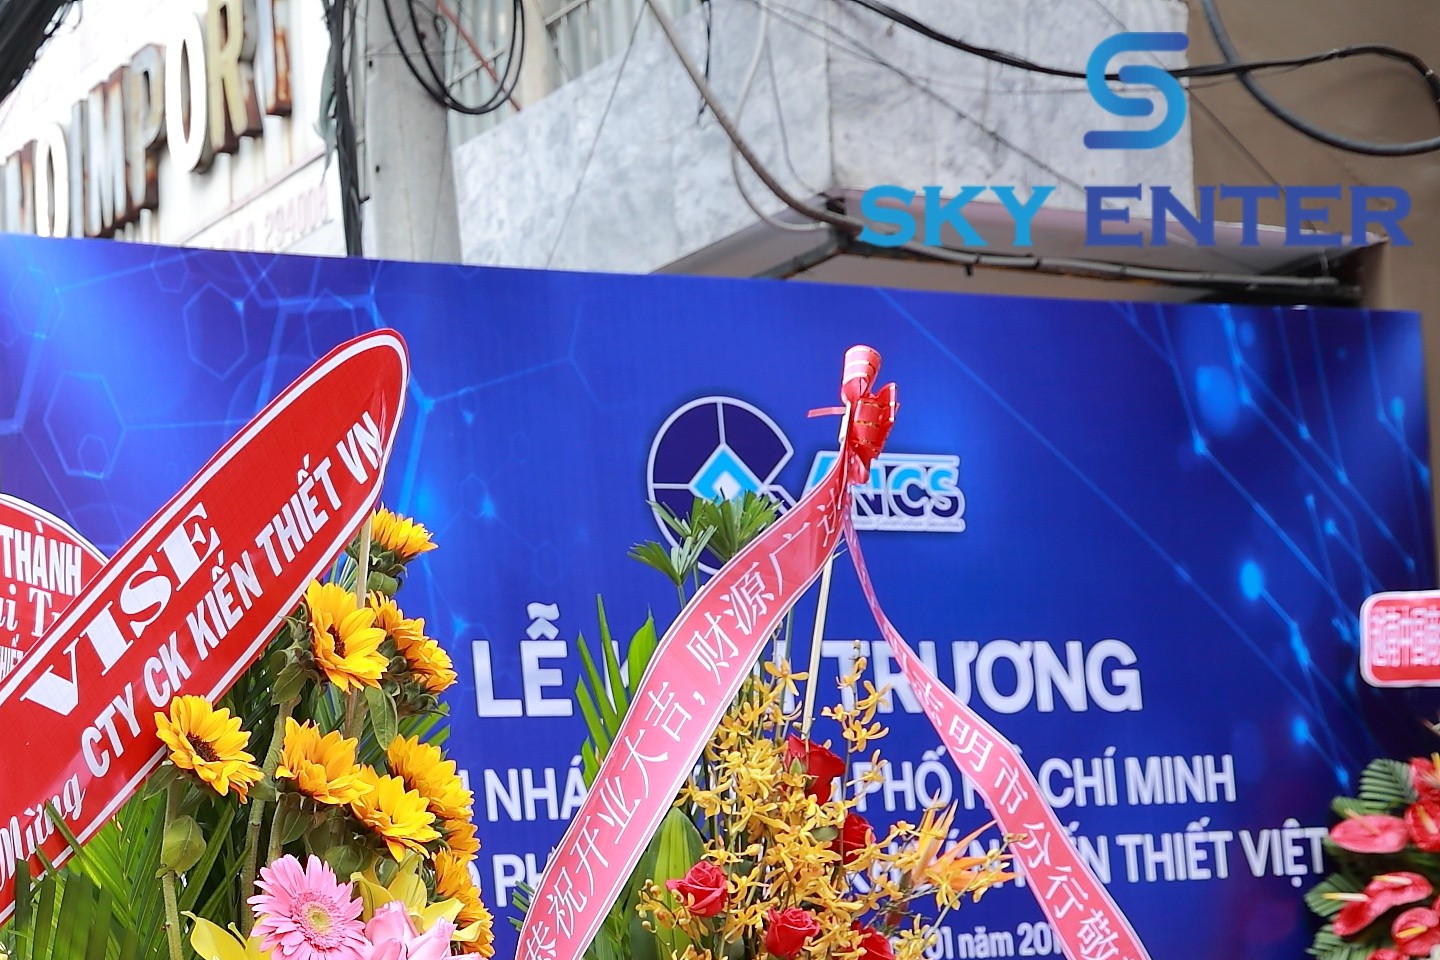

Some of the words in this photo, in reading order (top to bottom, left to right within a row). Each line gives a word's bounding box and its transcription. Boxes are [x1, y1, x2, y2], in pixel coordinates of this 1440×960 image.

[19, 502, 222, 716] VISE
[81, 682, 142, 779] CTY
[143, 635, 193, 708] CK
[185, 550, 265, 662] KIẾN
[256, 454, 344, 574] THIẾT
[336, 410, 385, 486] VN
[472, 602, 573, 718] LỄ
[484, 754, 592, 822] NHÁ
[852, 745, 954, 812] PHỐ
[1038, 746, 1118, 807] CHÍ
[1126, 754, 1237, 805] MINH
[1116, 817, 1234, 882] THIẾT
[1238, 818, 1329, 888] VIỆT
[957, 925, 1015, 960] năm
